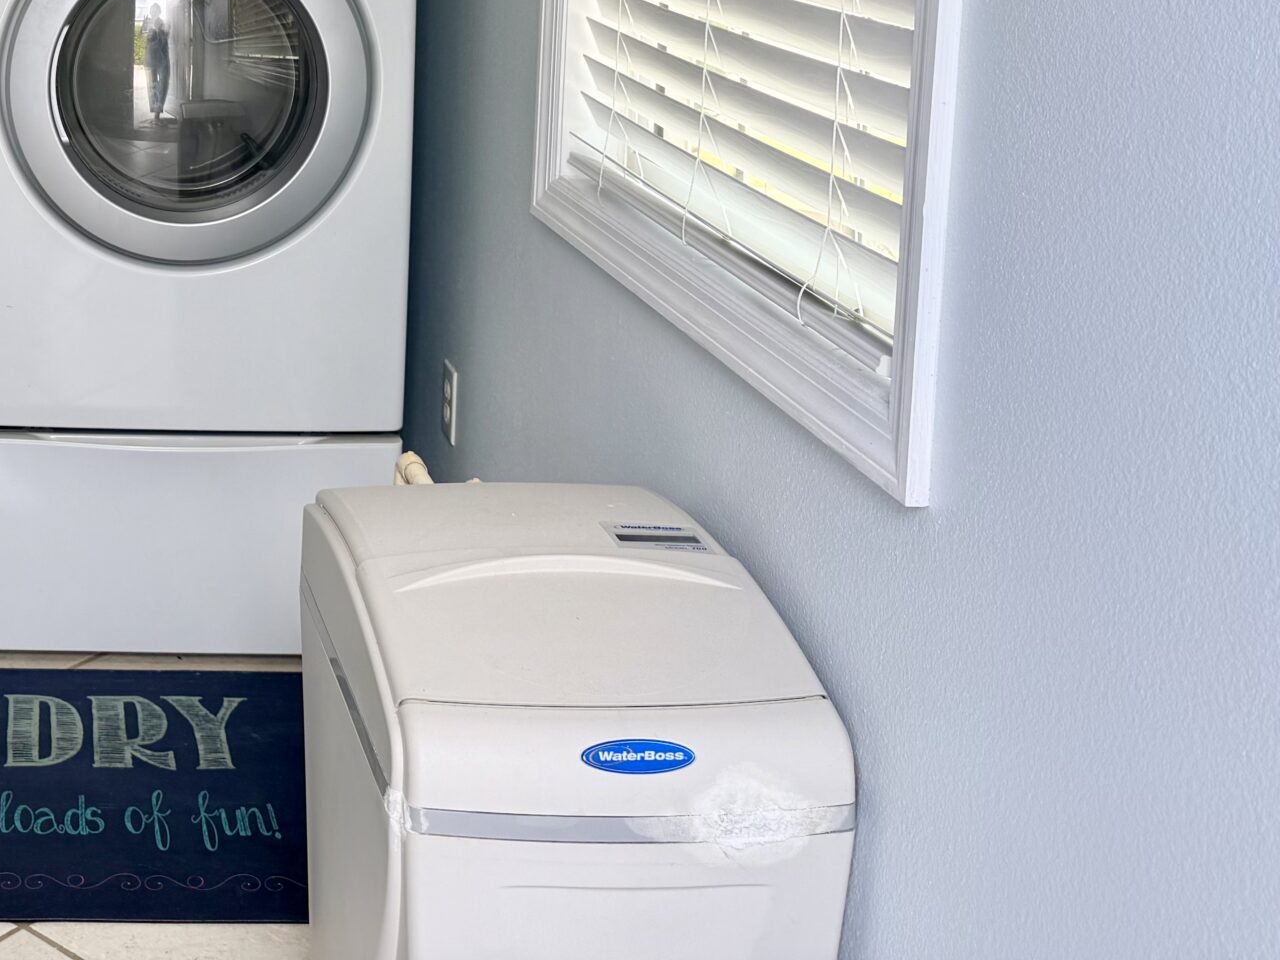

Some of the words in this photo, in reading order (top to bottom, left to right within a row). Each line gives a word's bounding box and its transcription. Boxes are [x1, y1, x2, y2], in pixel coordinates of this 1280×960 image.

[599, 750, 685, 761] WaterBoss
[124, 790, 171, 851] of
[191, 790, 282, 851] fun!
